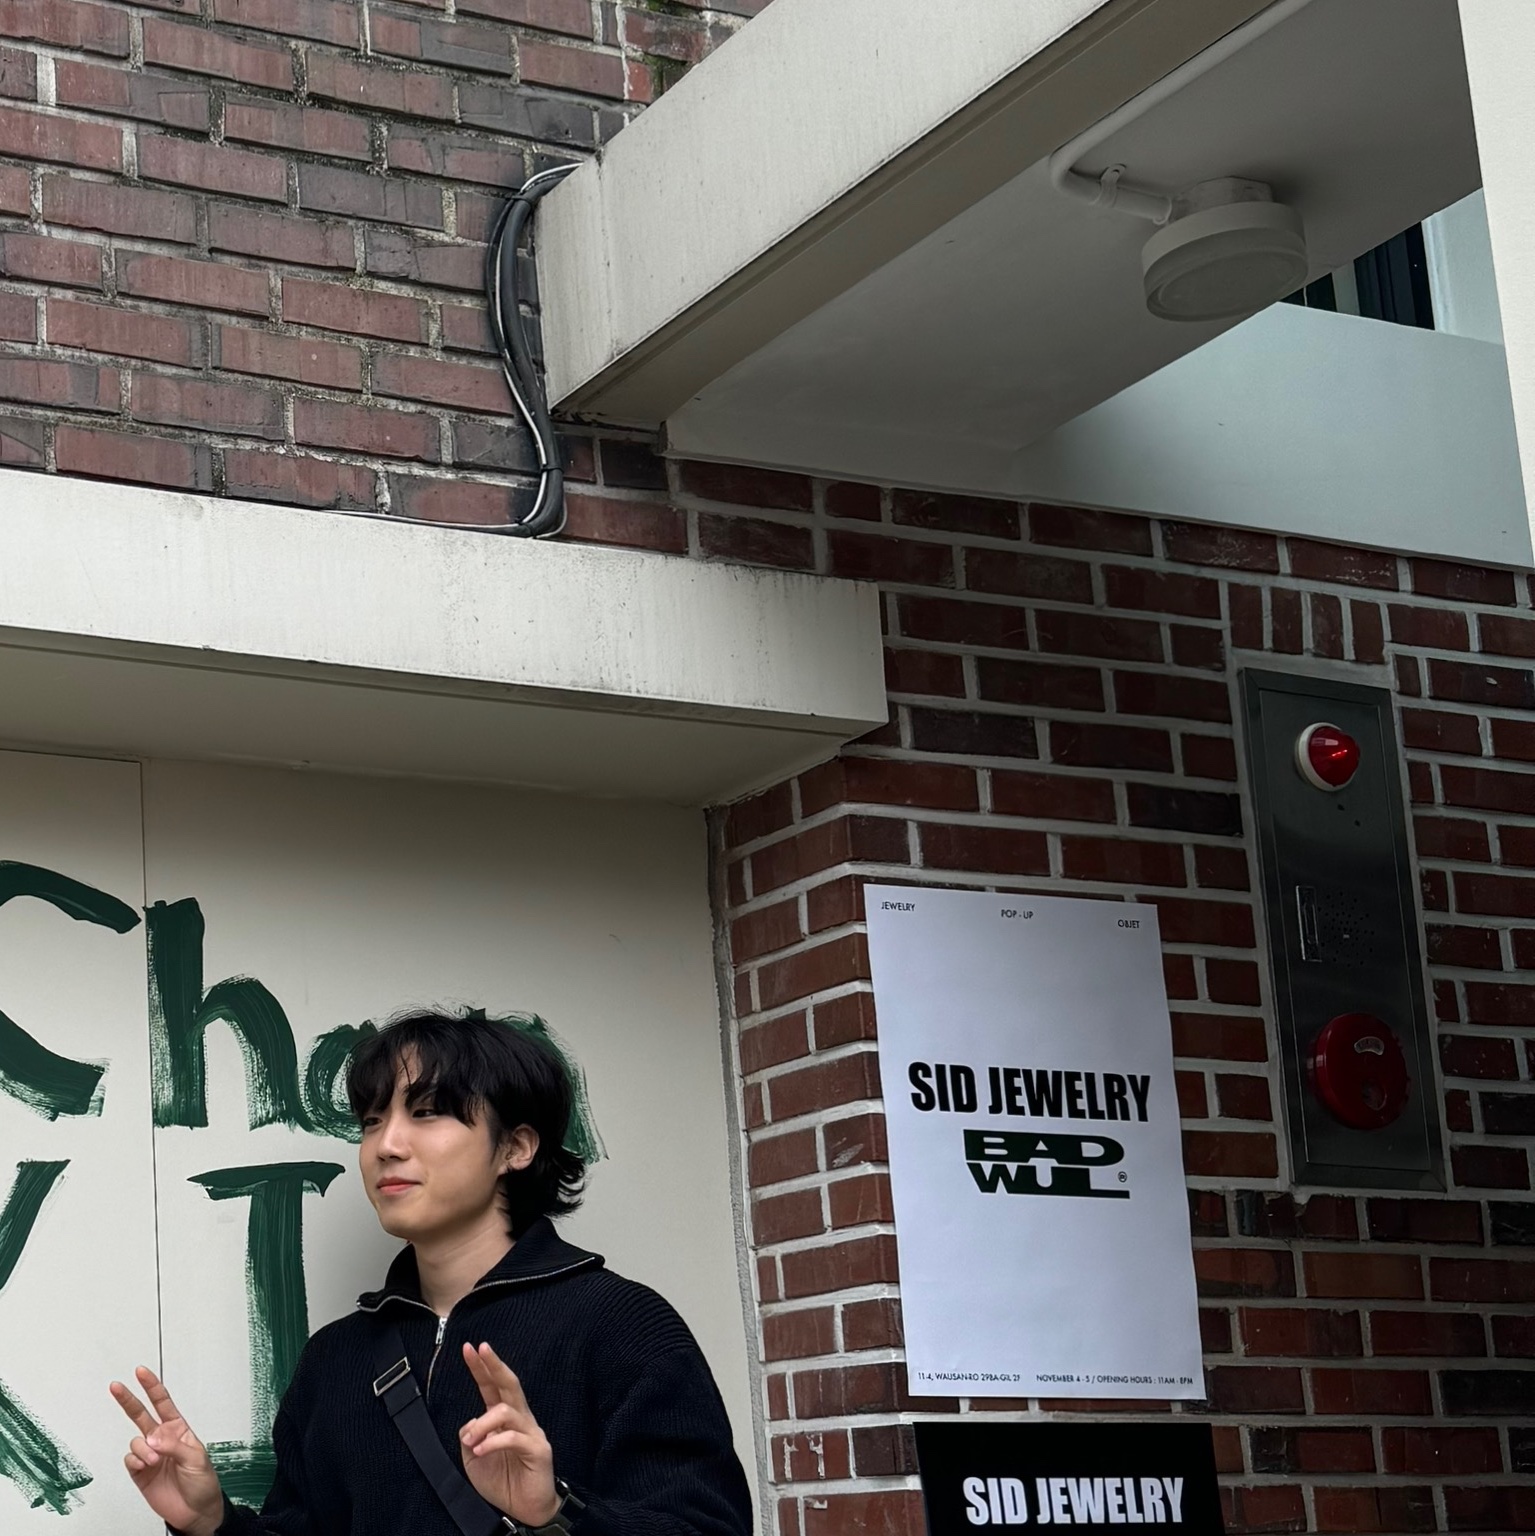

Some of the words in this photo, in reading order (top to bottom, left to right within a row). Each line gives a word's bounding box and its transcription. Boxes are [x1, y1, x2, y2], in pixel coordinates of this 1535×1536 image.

[881, 901, 915, 911] JEWELRY
[1001, 909, 1017, 918] POP
[1023, 910, 1034, 919] UP
[1117, 919, 1140, 928] OBJET
[908, 1061, 978, 1113] SID
[988, 1066, 1151, 1122] JEWELRY
[963, 1129, 1125, 1166] BAD
[1036, 1374, 1074, 1383] NOVEMBER
[1097, 1375, 1129, 1384] OPENING
[1130, 1376, 1152, 1384] HOURS
[963, 1476, 1028, 1525] SID
[1036, 1477, 1184, 1524] JEWELRY
